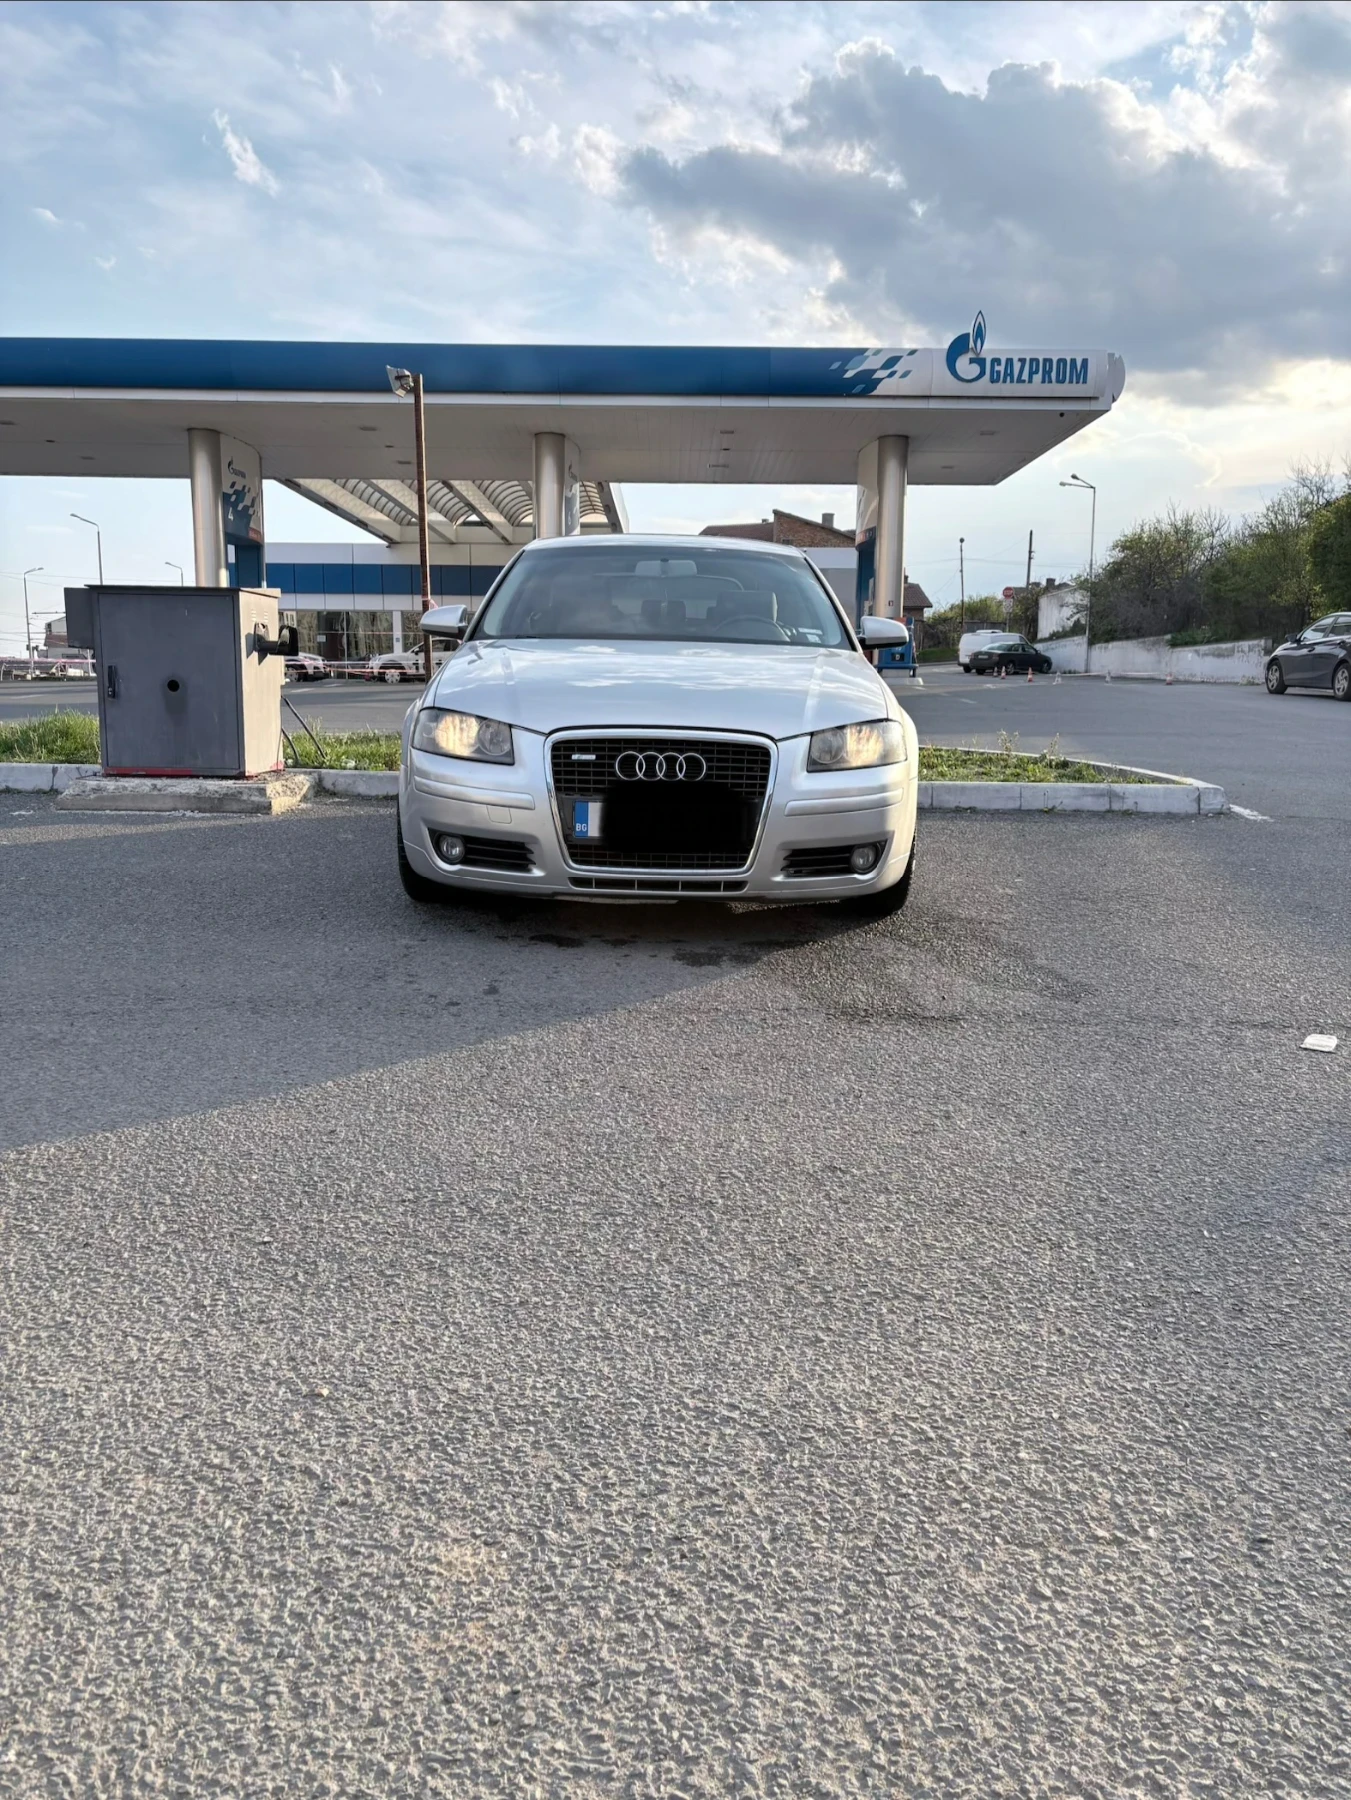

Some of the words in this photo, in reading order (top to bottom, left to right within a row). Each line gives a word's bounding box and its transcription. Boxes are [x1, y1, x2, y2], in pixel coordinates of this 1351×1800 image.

[989, 357, 1089, 385] GAZPROM
[228, 507, 234, 521] 4
[575, 823, 587, 831] BG
